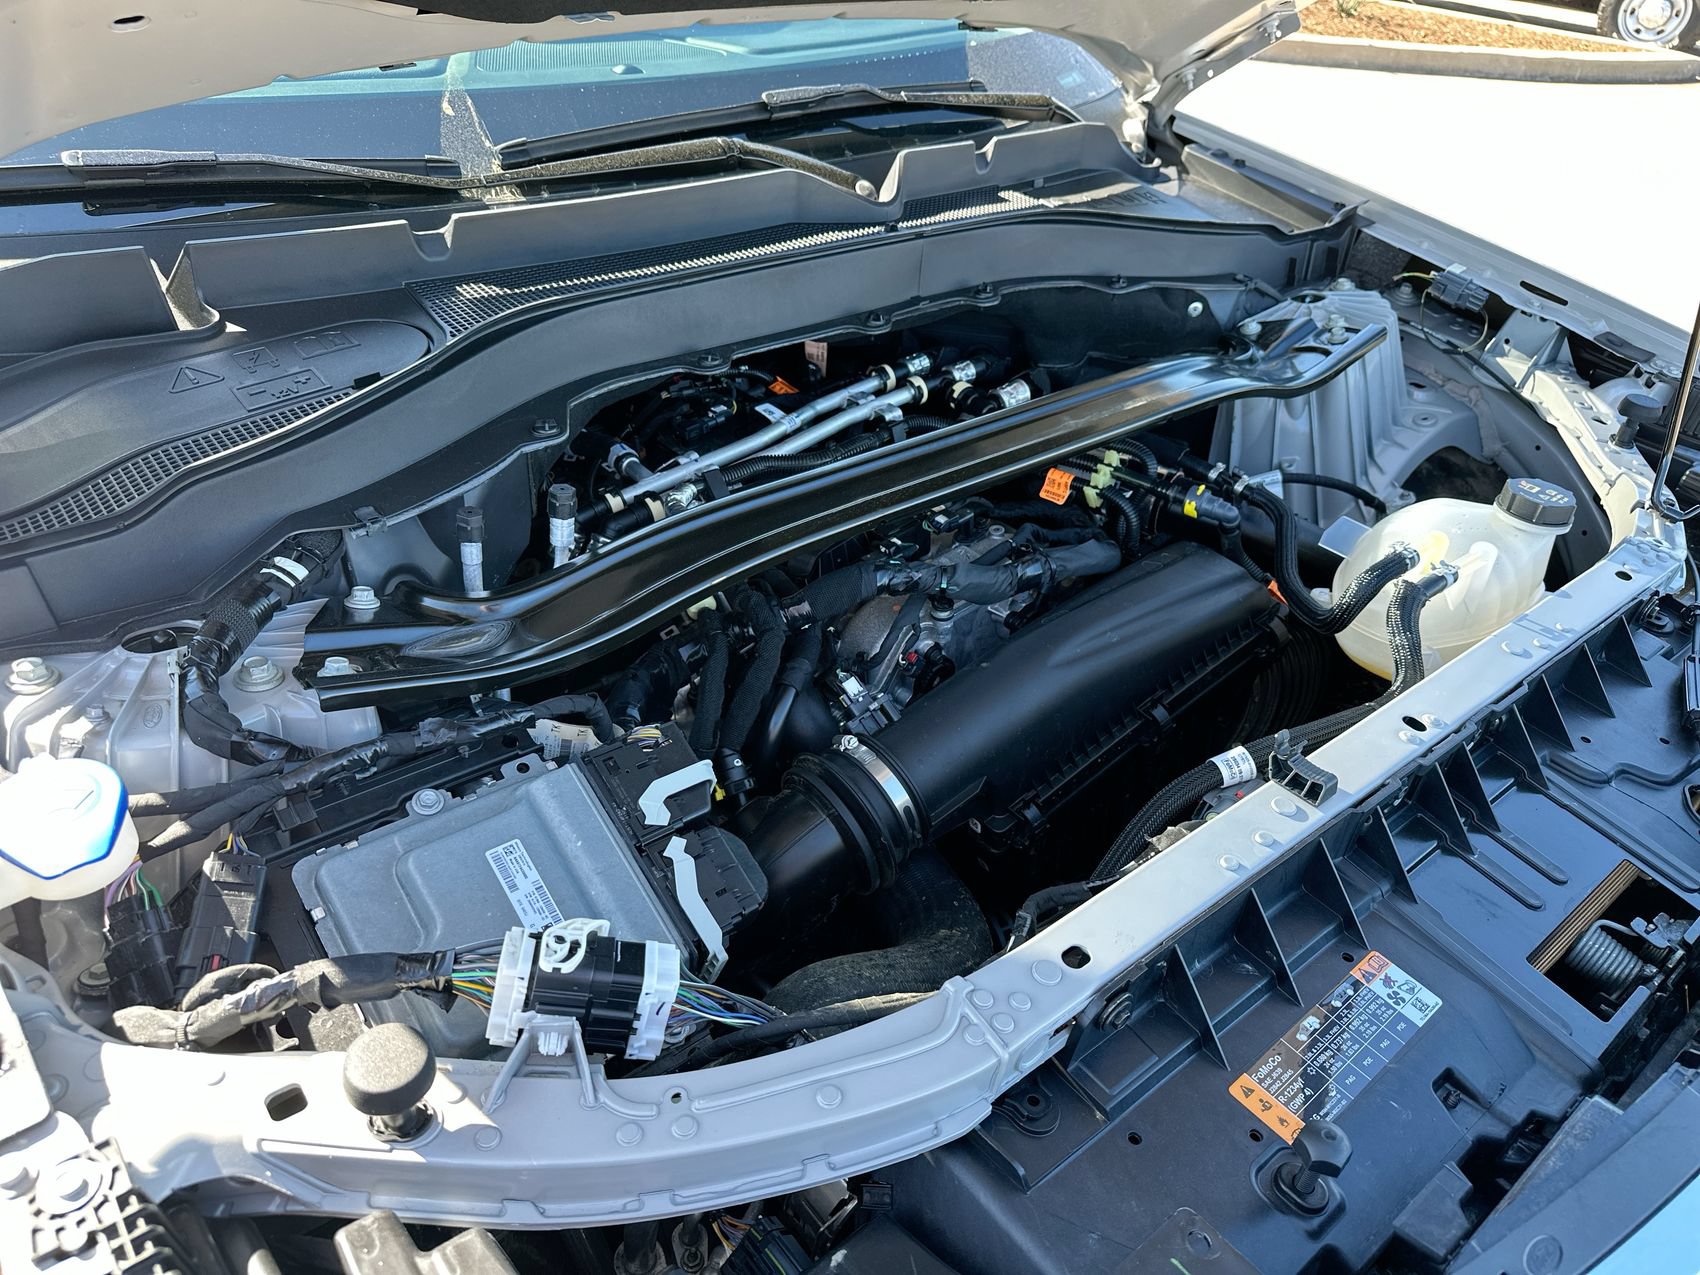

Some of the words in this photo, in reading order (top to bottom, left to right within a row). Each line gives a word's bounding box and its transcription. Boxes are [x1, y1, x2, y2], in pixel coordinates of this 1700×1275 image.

[1396, 1022, 1407, 1031] POE
[1380, 1039, 1390, 1049] PAG
[1363, 1057, 1374, 1066] POE
[1251, 1055, 1282, 1082] FoMoCo
[1261, 1077, 1273, 1088] SAE
[1345, 1075, 1356, 1085] PAG
[1277, 1077, 1305, 1104] R-1234yf
[1287, 1093, 1306, 1112] (GWP
[1303, 1087, 1314, 1097] 4)
